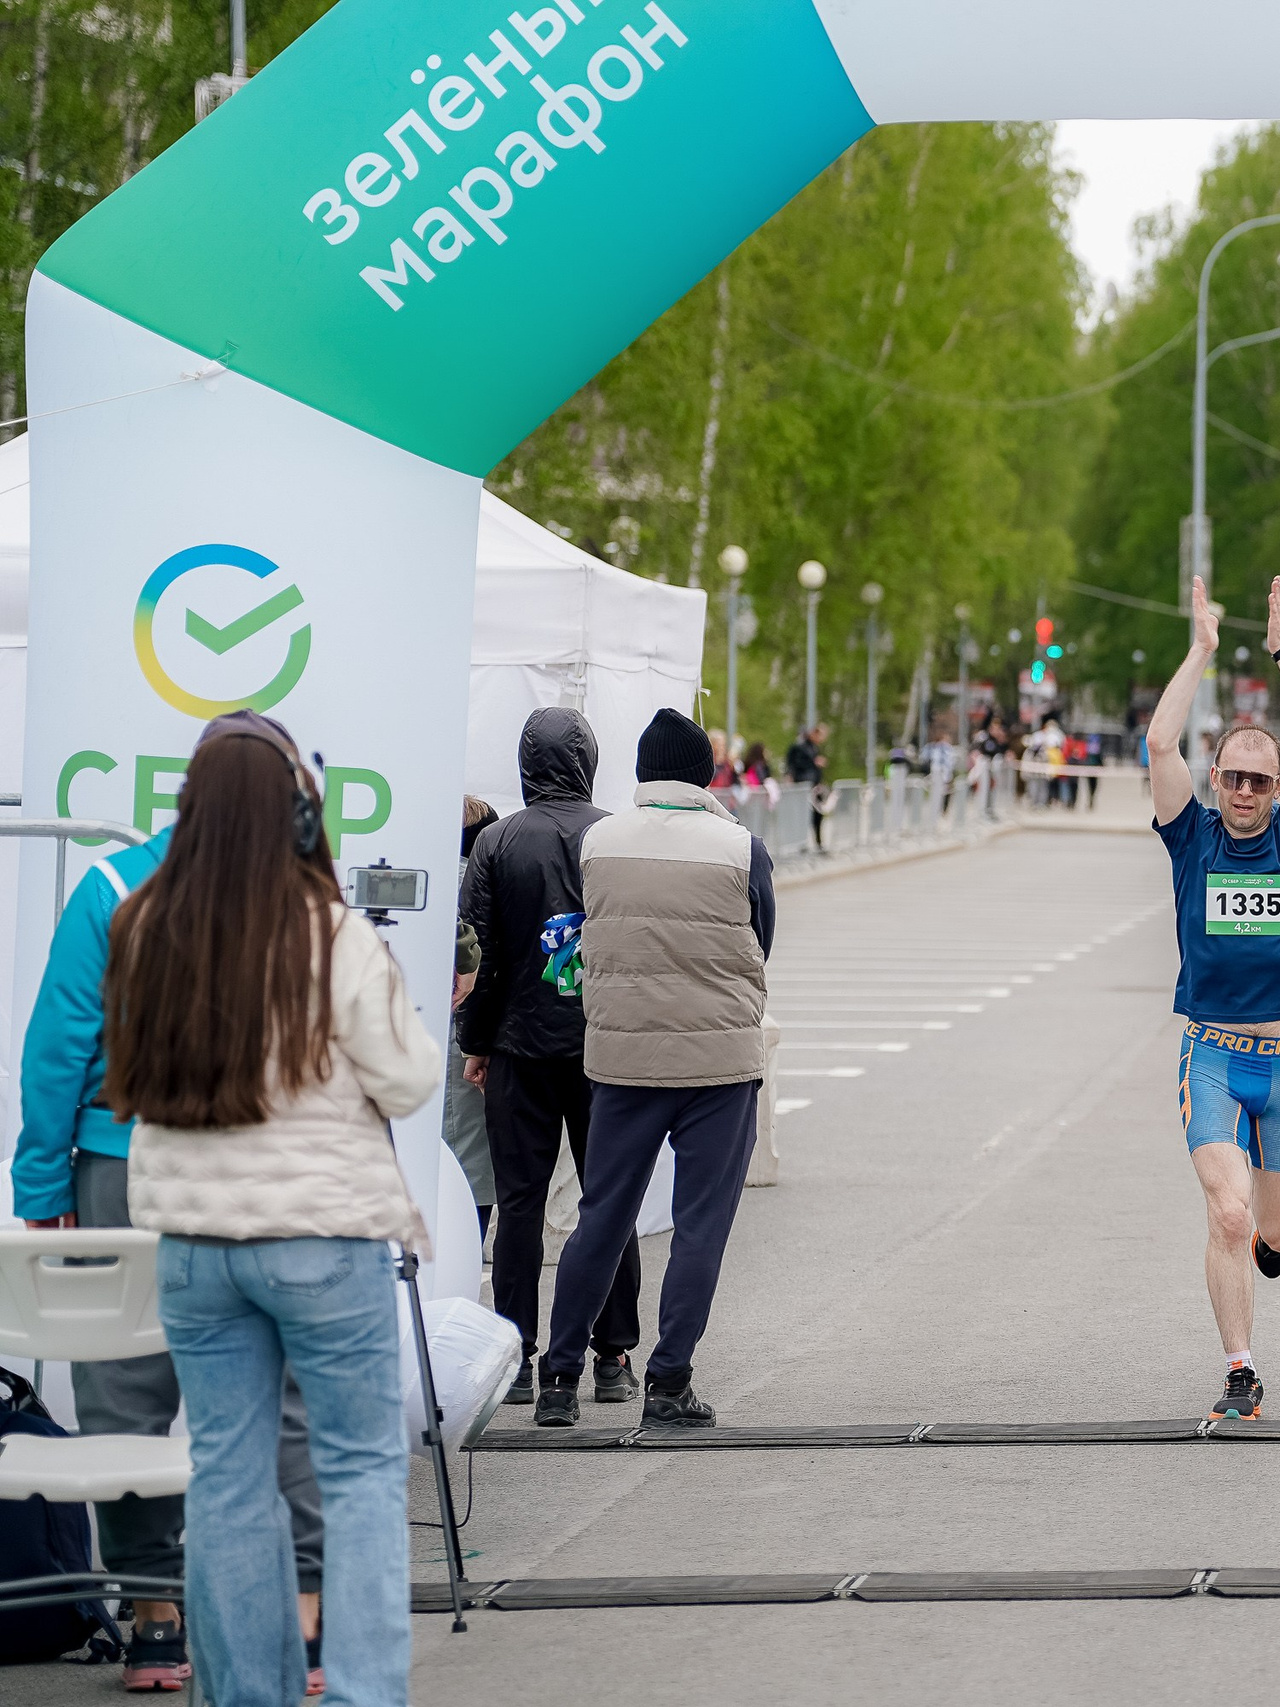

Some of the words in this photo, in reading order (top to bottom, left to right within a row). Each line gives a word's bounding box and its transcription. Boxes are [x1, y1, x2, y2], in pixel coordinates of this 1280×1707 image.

[302, 0, 601, 246] зелёны
[358, 0, 690, 312] марафон
[1234, 922, 1251, 934] 4,2
[1200, 1027, 1254, 1053] PRO
